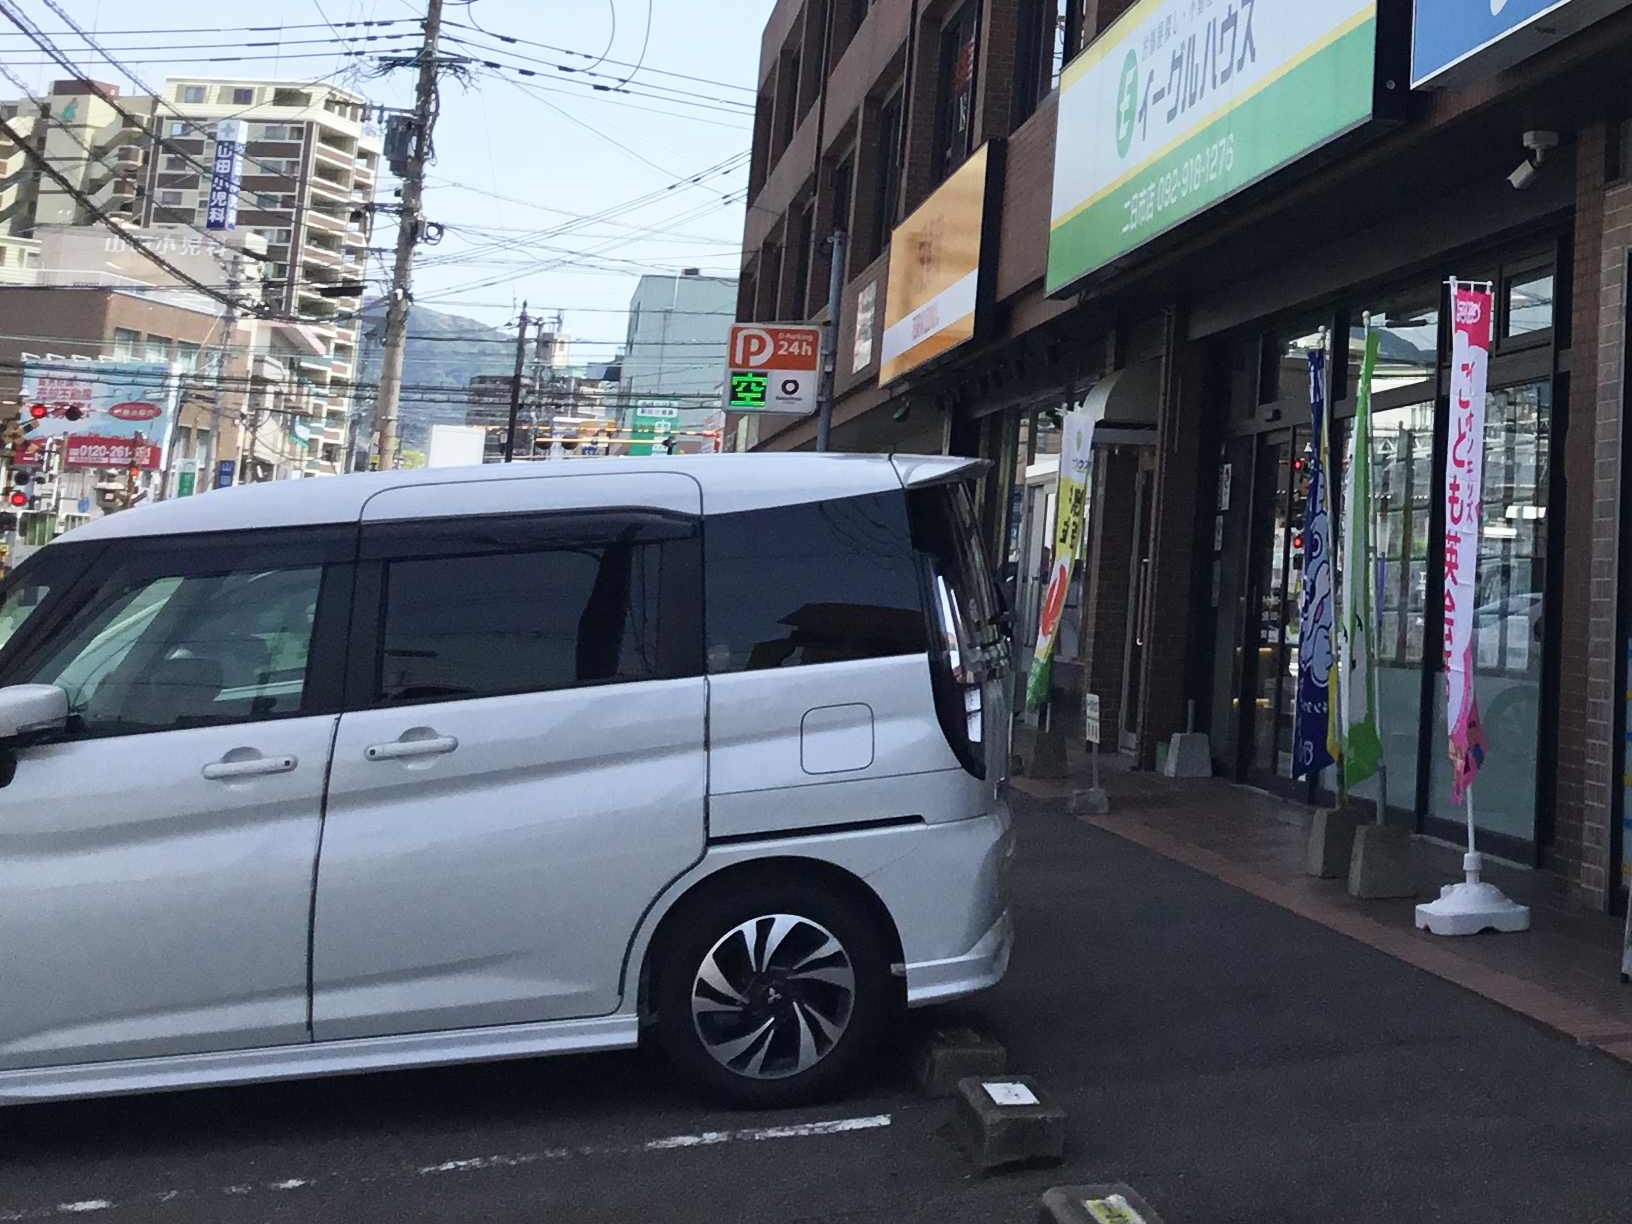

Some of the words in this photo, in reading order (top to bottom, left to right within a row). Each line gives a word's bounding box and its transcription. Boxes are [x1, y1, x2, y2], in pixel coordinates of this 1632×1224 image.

[208, 143, 233, 223] 山田小児科
[1156, 132, 1234, 212] 092-918-1276
[777, 340, 812, 356] 24h
[730, 372, 767, 407] 空
